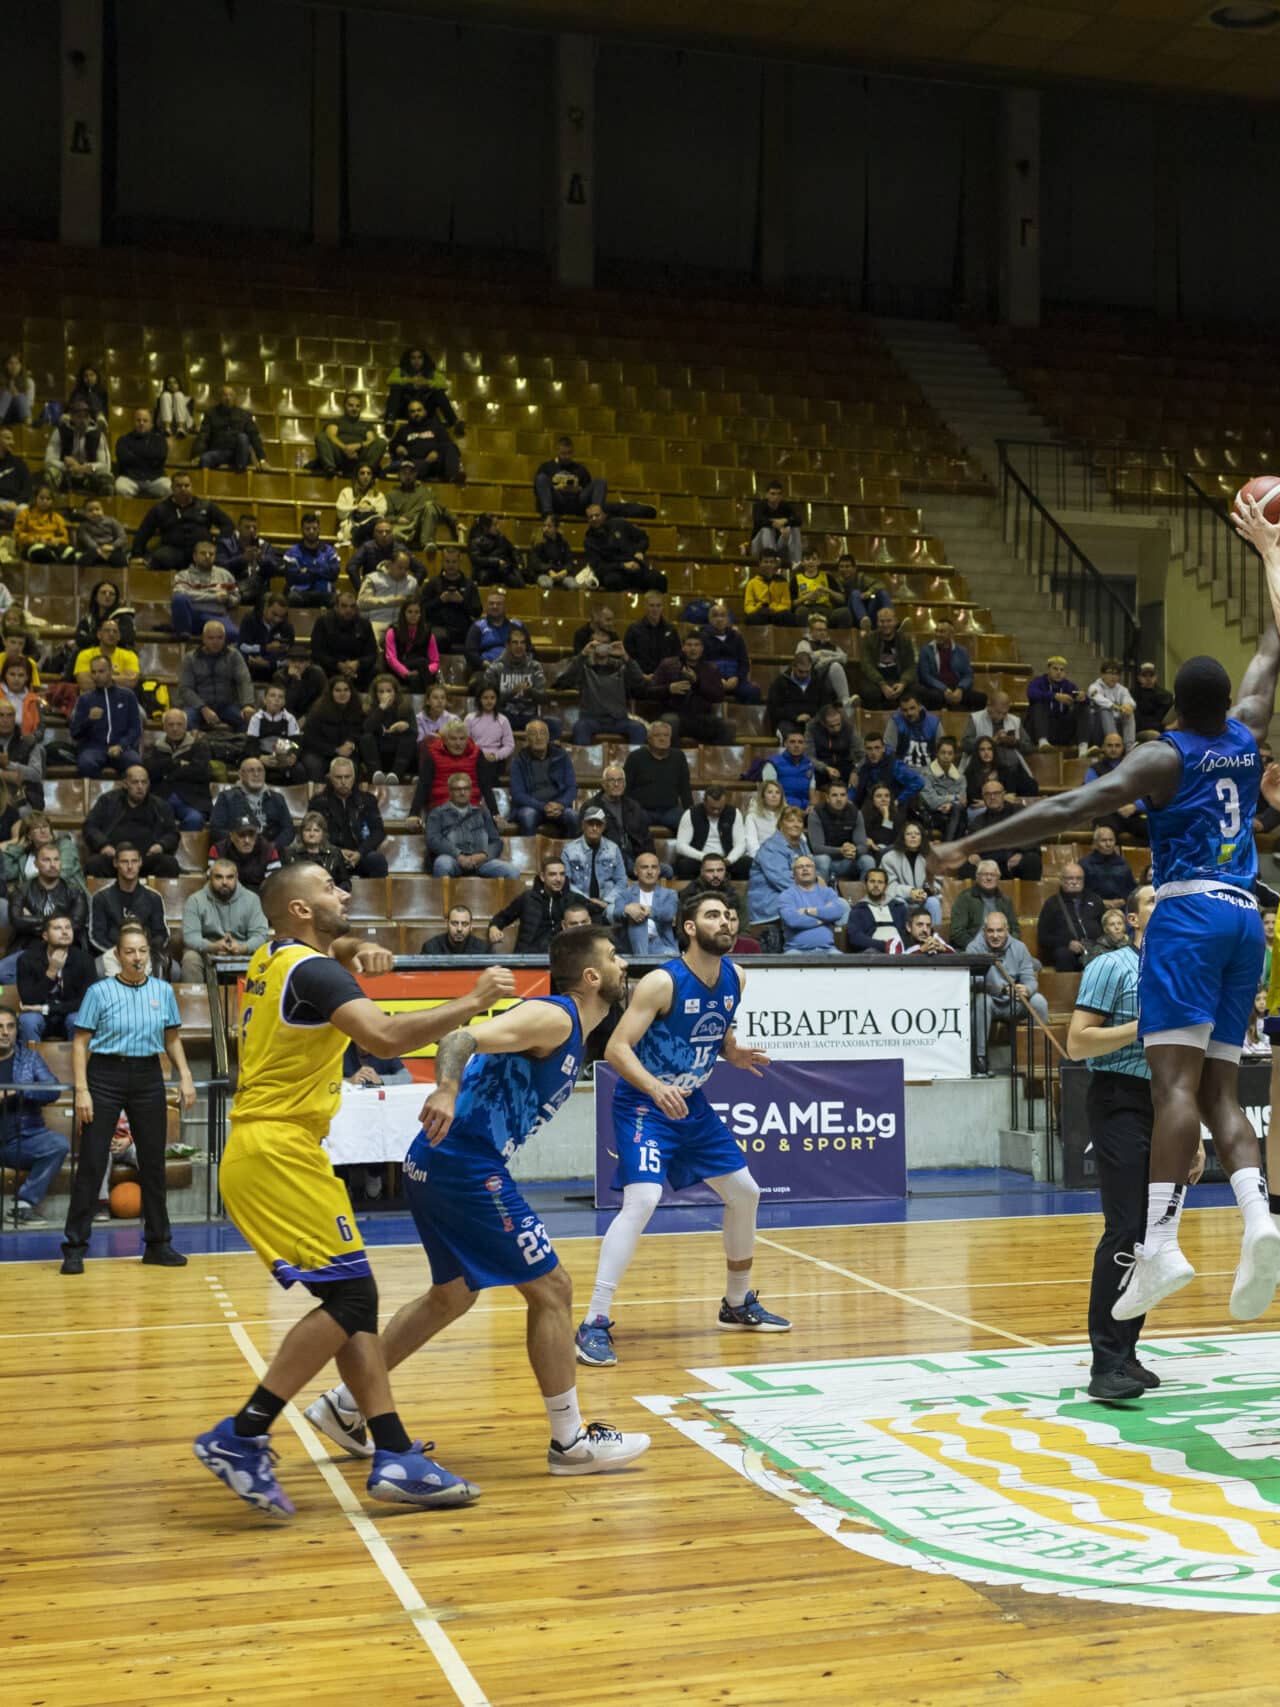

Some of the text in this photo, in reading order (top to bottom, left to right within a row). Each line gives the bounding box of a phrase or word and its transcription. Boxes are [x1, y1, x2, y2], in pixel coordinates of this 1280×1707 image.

[1216, 777, 1240, 838] 3
[746, 1009, 882, 1037] КВАРТА
[891, 1008, 962, 1038] ООД
[710, 1101, 896, 1138] SAME.bg
[639, 1146, 661, 1173] 15
[736, 1137, 876, 1152] NO & SPORT
[336, 1216, 353, 1242] 6
[516, 1223, 552, 1266] 23
